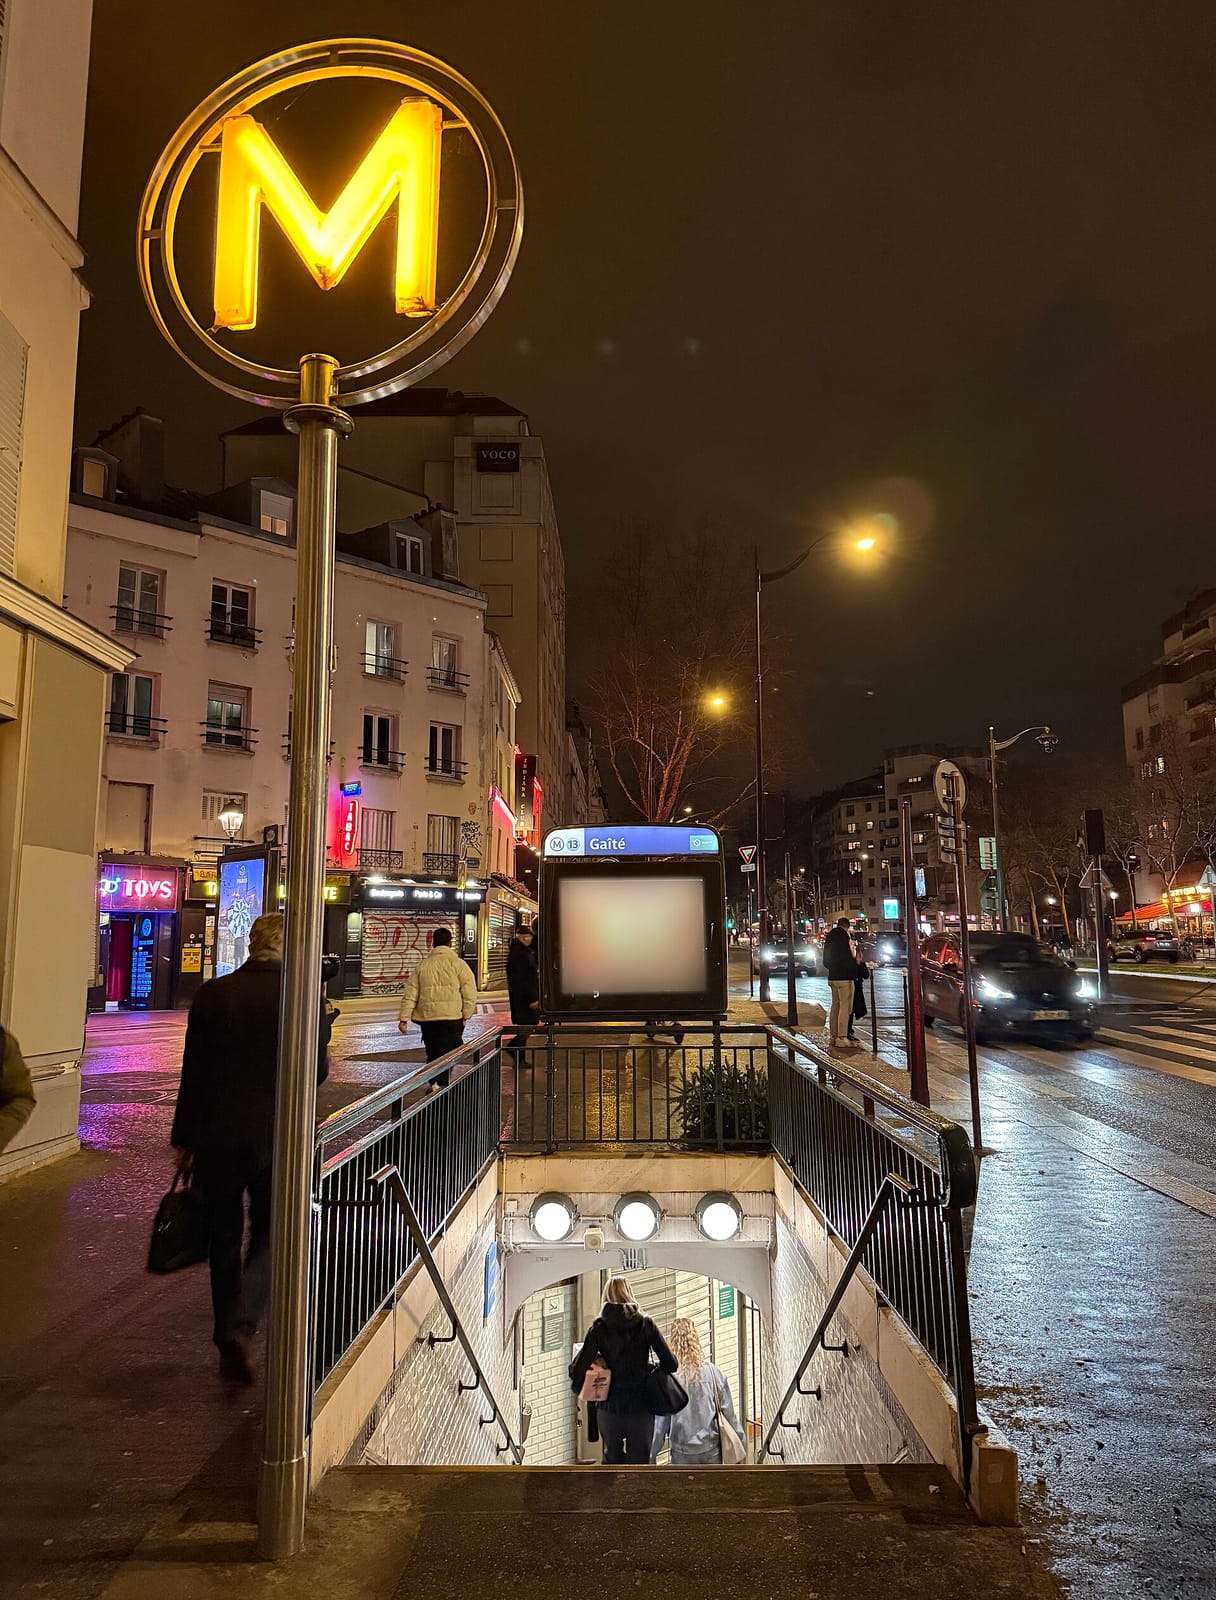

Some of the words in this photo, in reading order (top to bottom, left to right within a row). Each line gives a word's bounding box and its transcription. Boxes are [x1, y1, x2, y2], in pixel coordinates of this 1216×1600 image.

[213, 97, 443, 331] M
[344, 802, 354, 851] TABAC
[567, 839, 579, 849] 13
[590, 837, 626, 850] Gaîté
